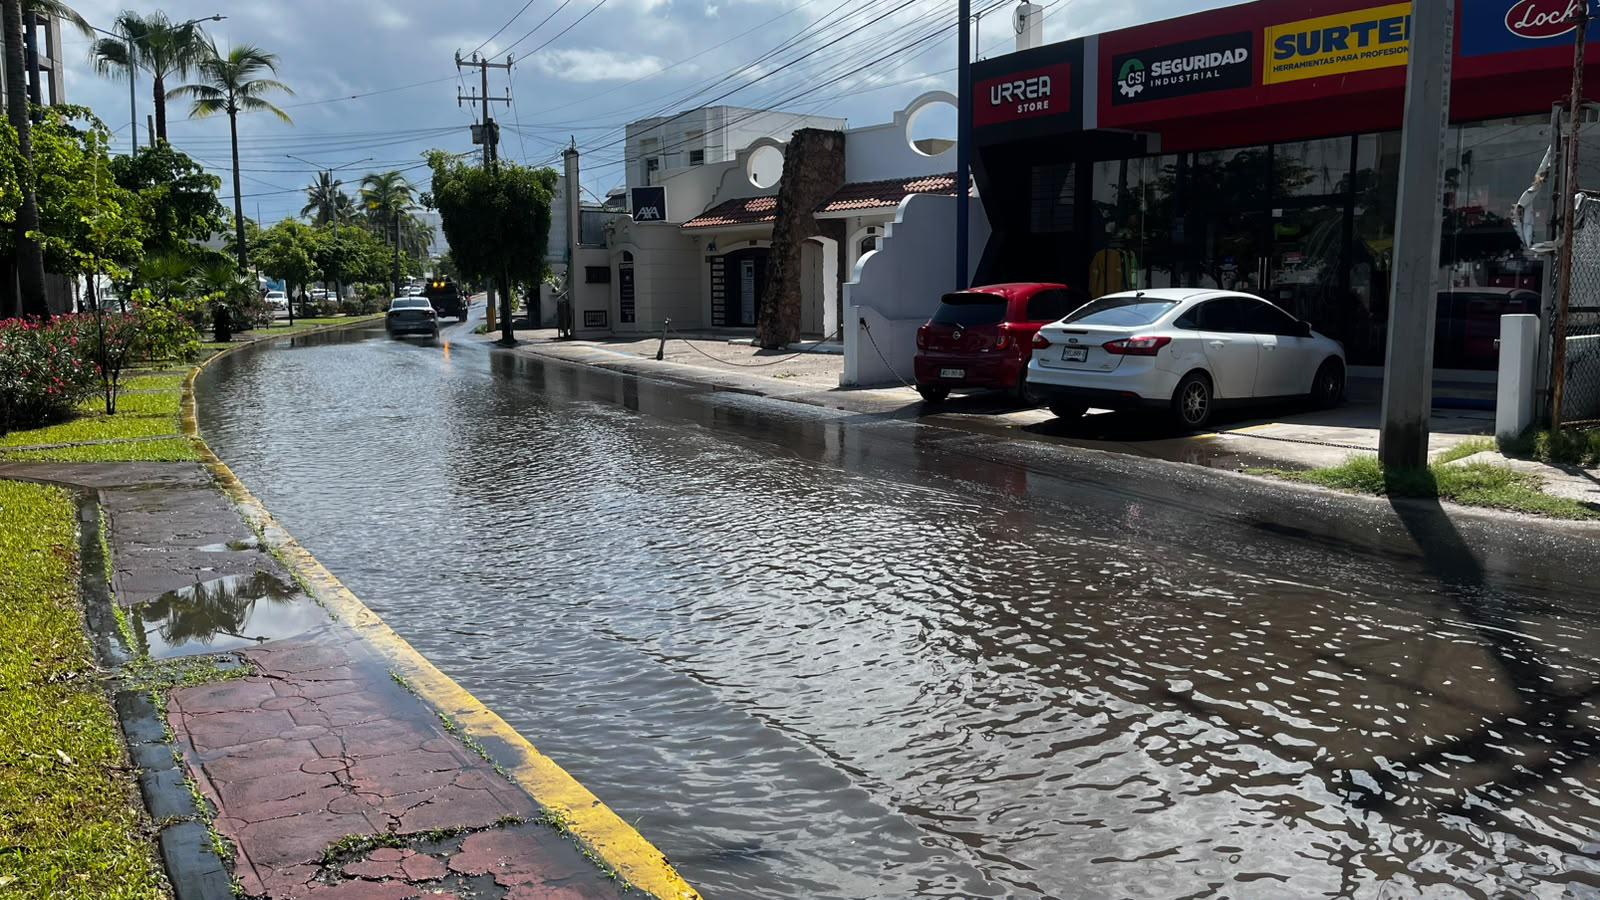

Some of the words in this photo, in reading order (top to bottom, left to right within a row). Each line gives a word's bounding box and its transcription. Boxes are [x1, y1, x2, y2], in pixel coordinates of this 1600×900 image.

[1151, 48, 1248, 77] SEGURIDAD
[1273, 57, 1335, 72] HERRAMIENTAS
[1336, 54, 1359, 63] PARA
[1128, 71, 1145, 84] CSI
[1151, 69, 1220, 87] INDUSTRIAL
[990, 75, 1051, 105] URREA
[1017, 100, 1049, 113] STORE
[635, 206, 660, 219] AXA
